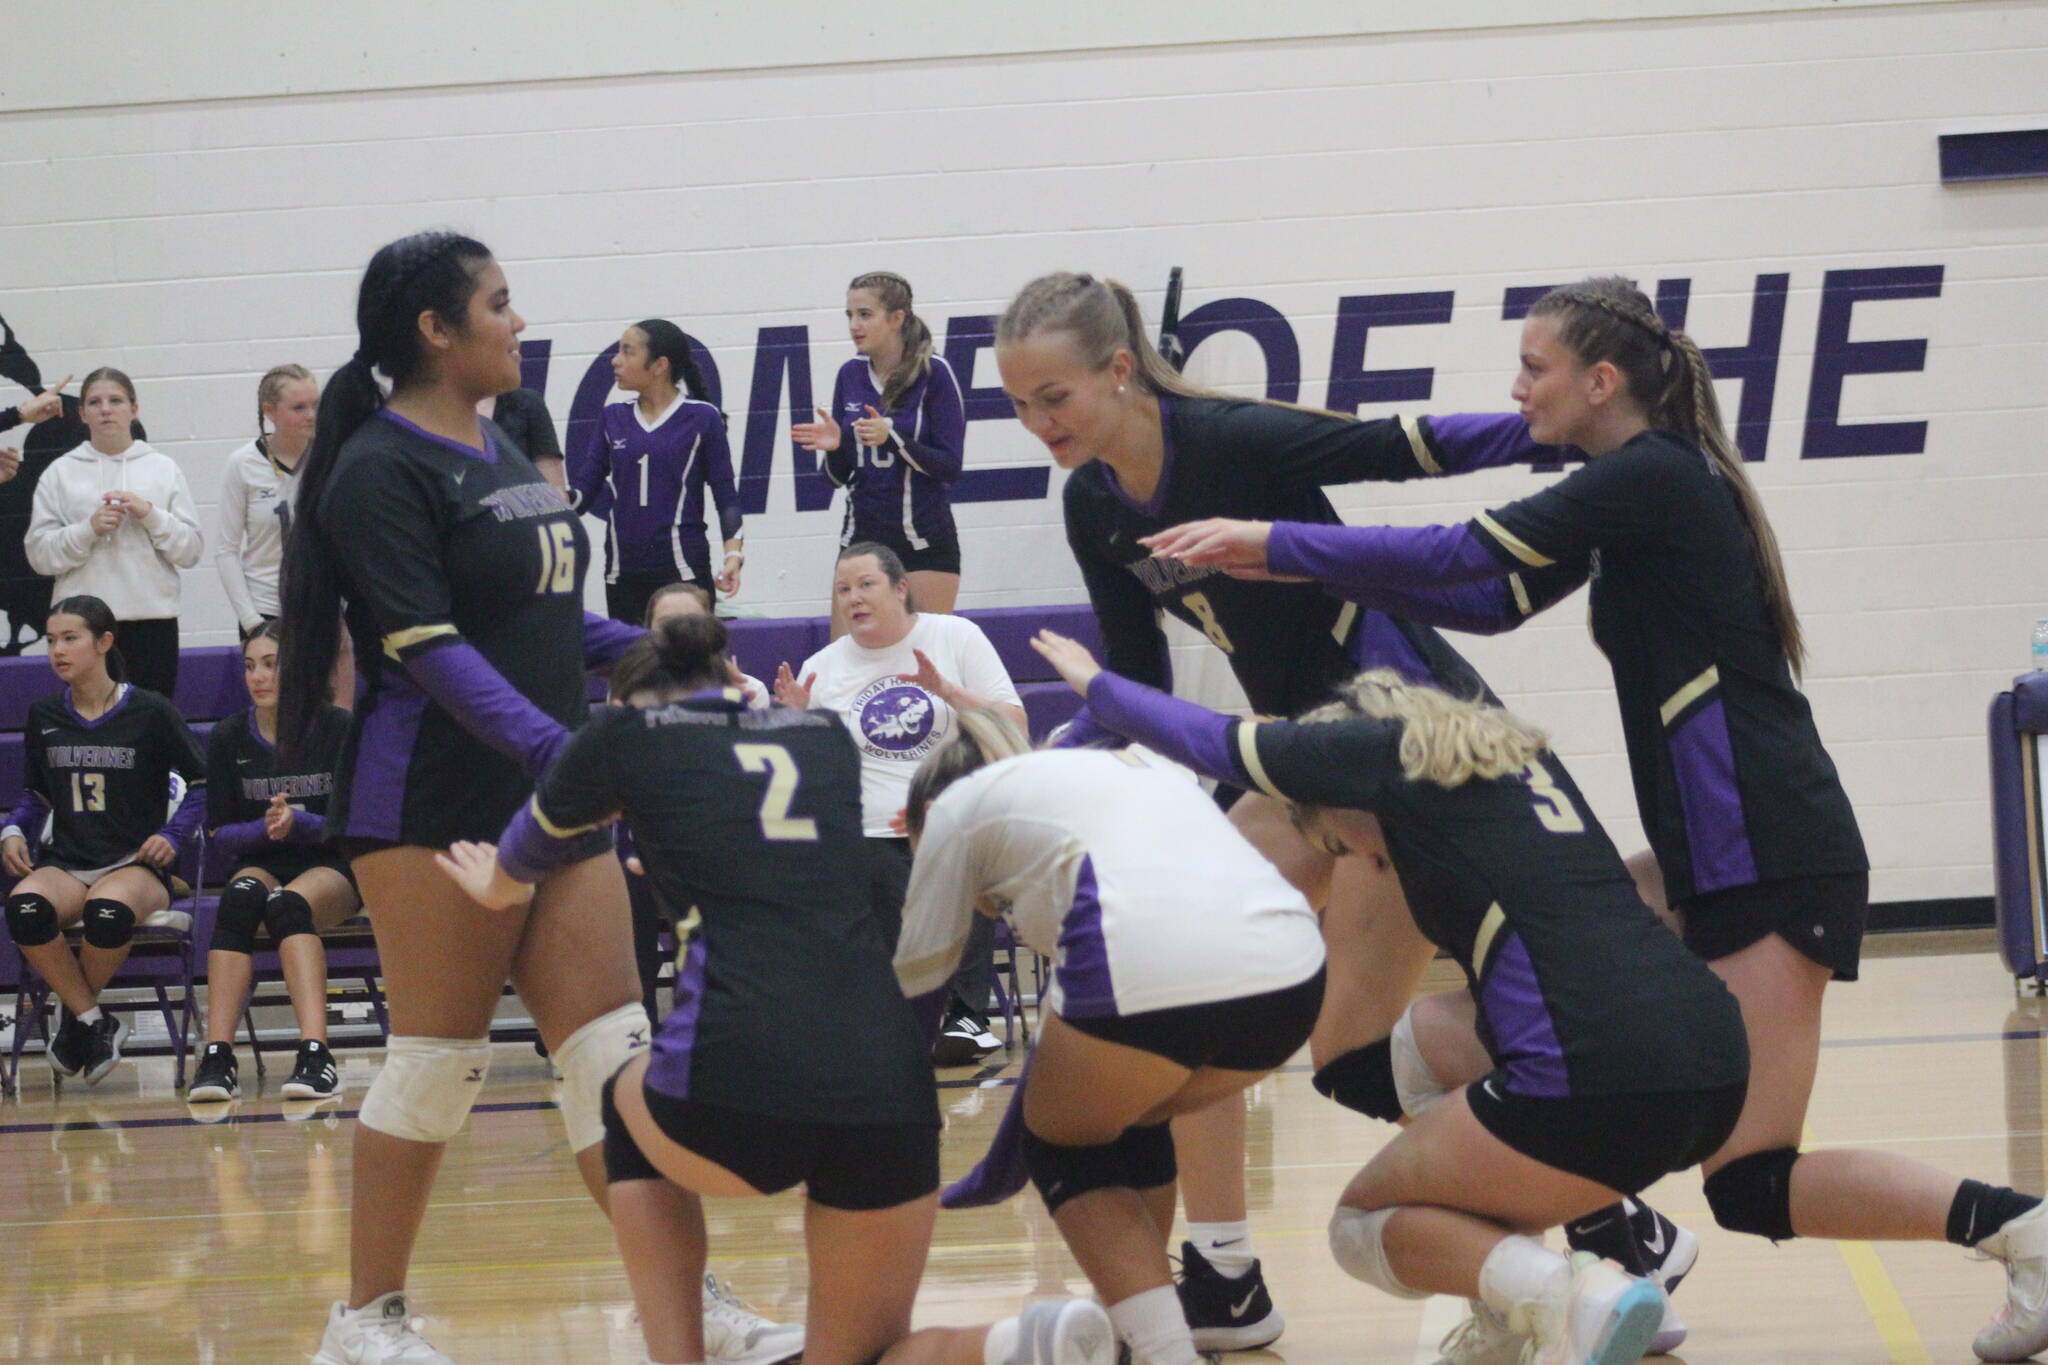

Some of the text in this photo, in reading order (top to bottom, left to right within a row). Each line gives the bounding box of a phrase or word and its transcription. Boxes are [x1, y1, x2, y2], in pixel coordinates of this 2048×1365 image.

[637, 453, 649, 507] 1
[536, 521, 575, 594] 16
[1181, 591, 1235, 653] 8
[47, 745, 136, 769] WOLVERINES
[70, 772, 107, 812] 13
[733, 743, 818, 840] 2
[1522, 757, 1585, 832] 3
